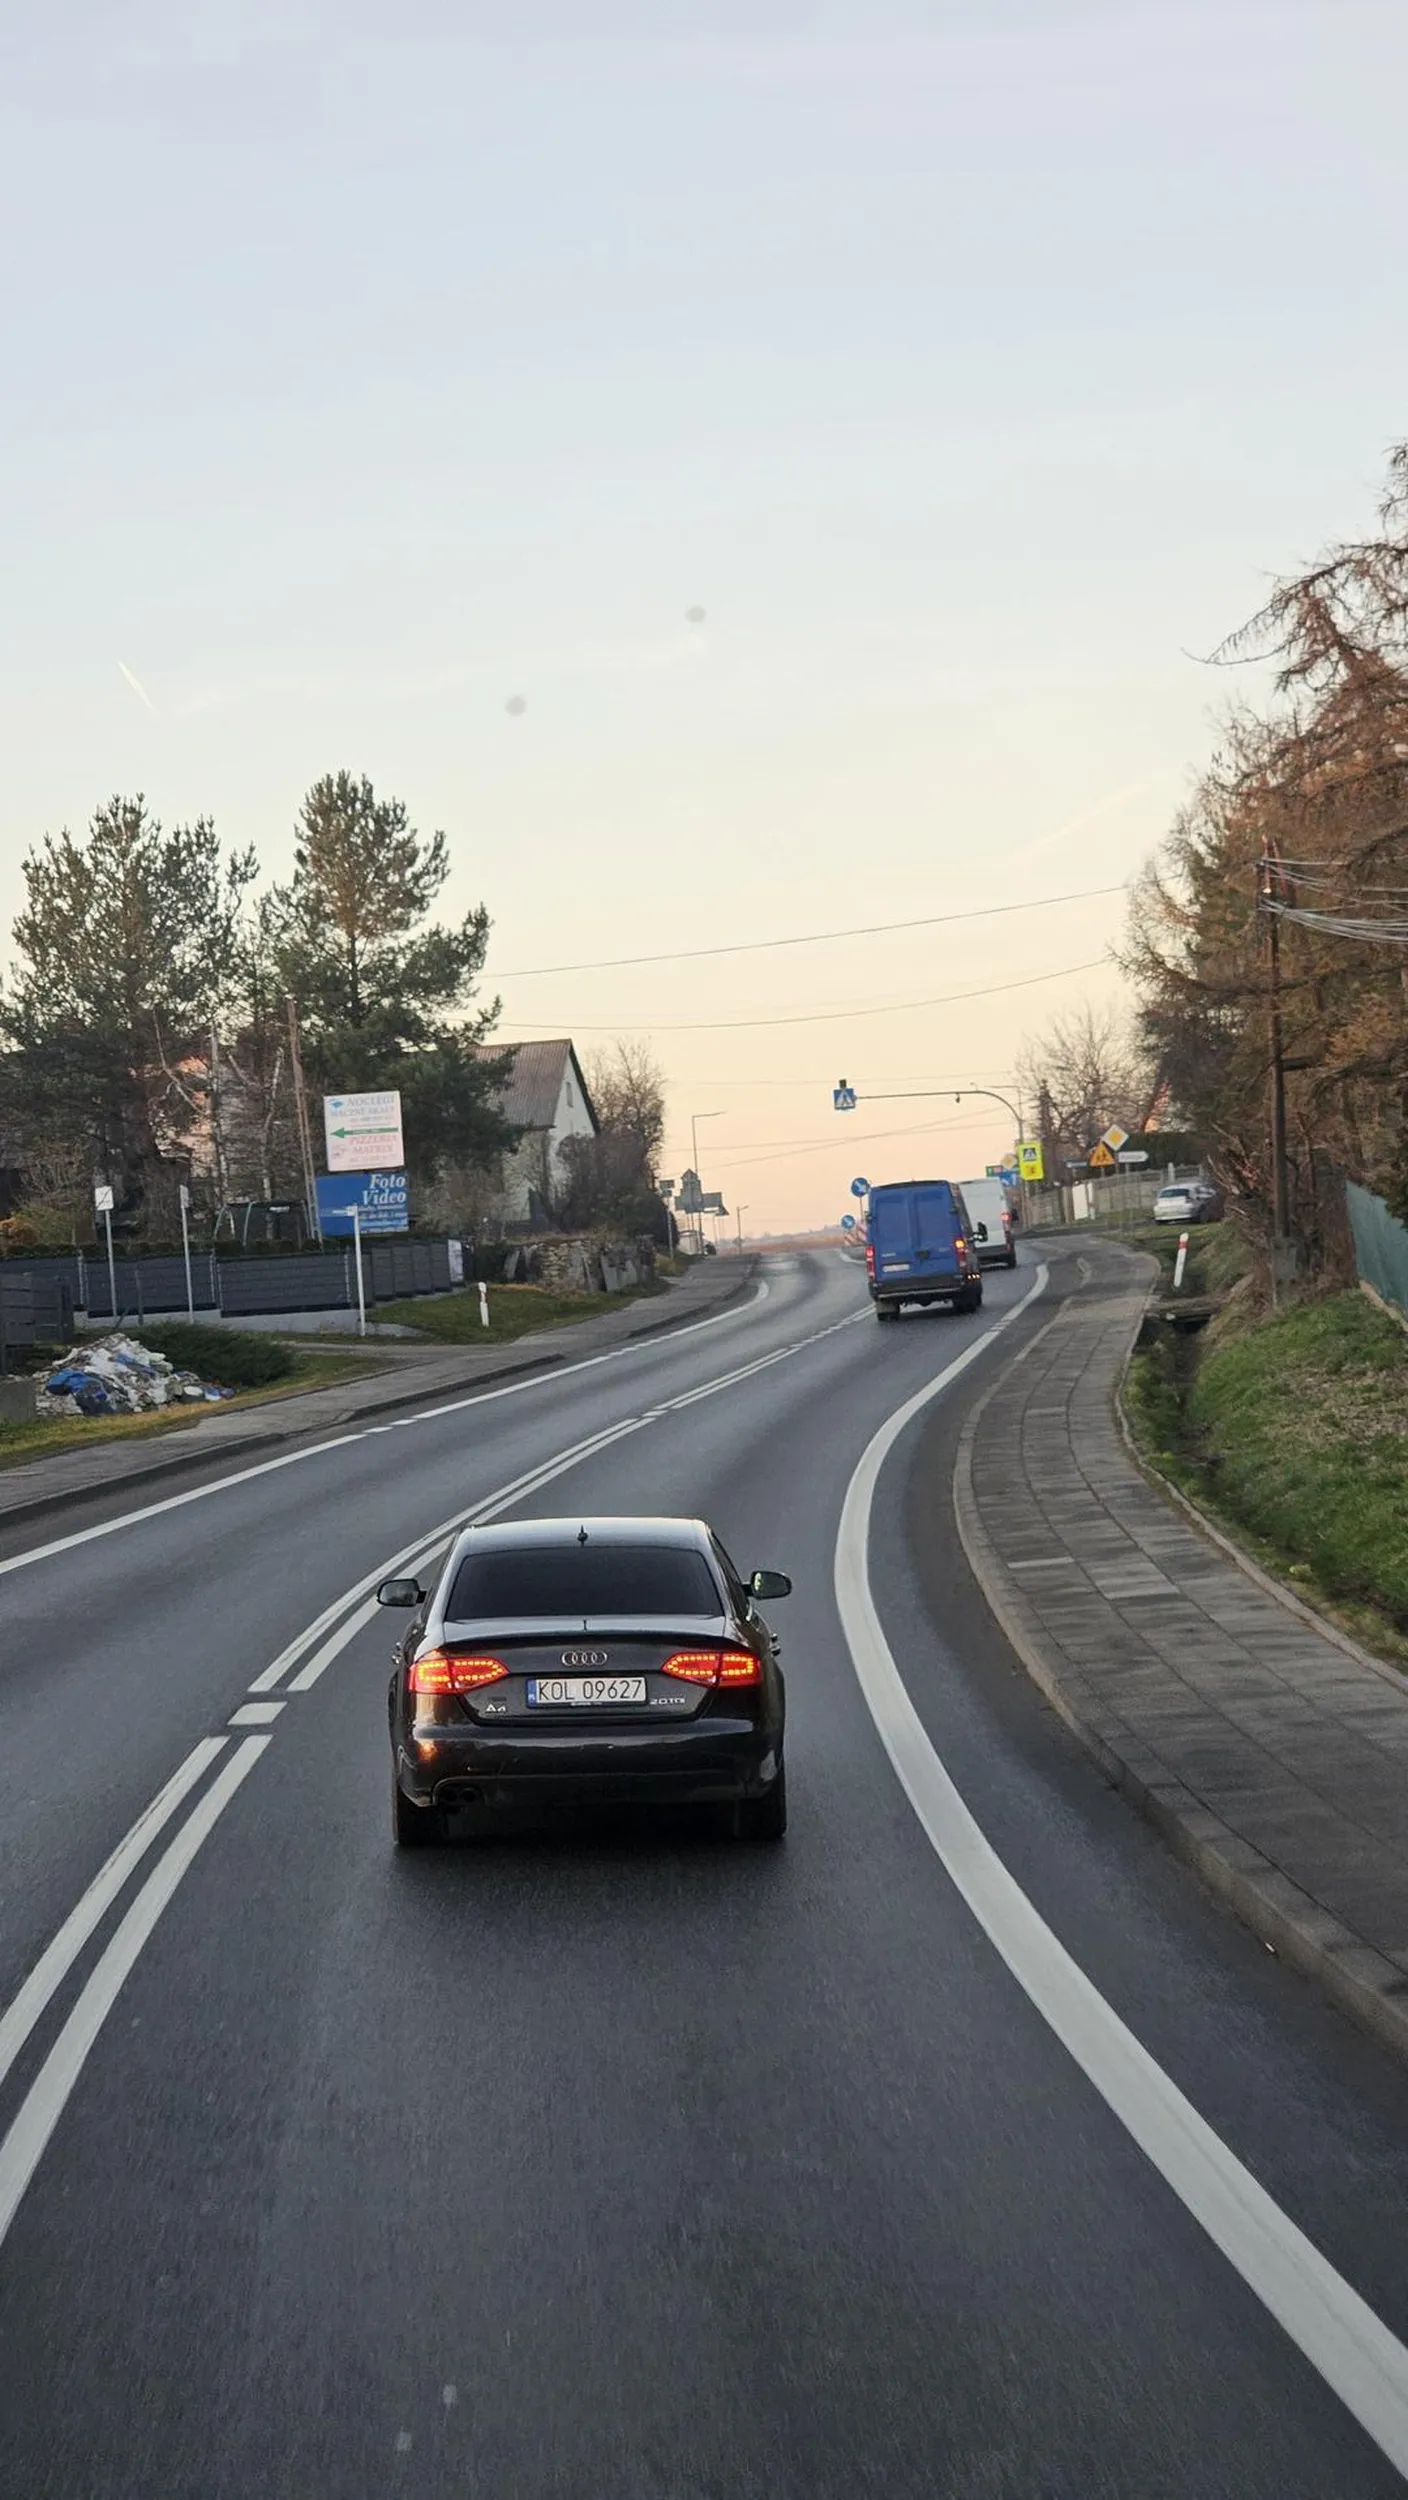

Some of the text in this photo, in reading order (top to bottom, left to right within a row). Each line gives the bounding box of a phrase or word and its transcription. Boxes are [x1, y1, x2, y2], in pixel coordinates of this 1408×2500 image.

[369, 1174, 406, 1189] Foto
[362, 1188, 407, 1204] Video
[538, 1680, 642, 1700] KOL 09627
[485, 1703, 506, 1712] A4
